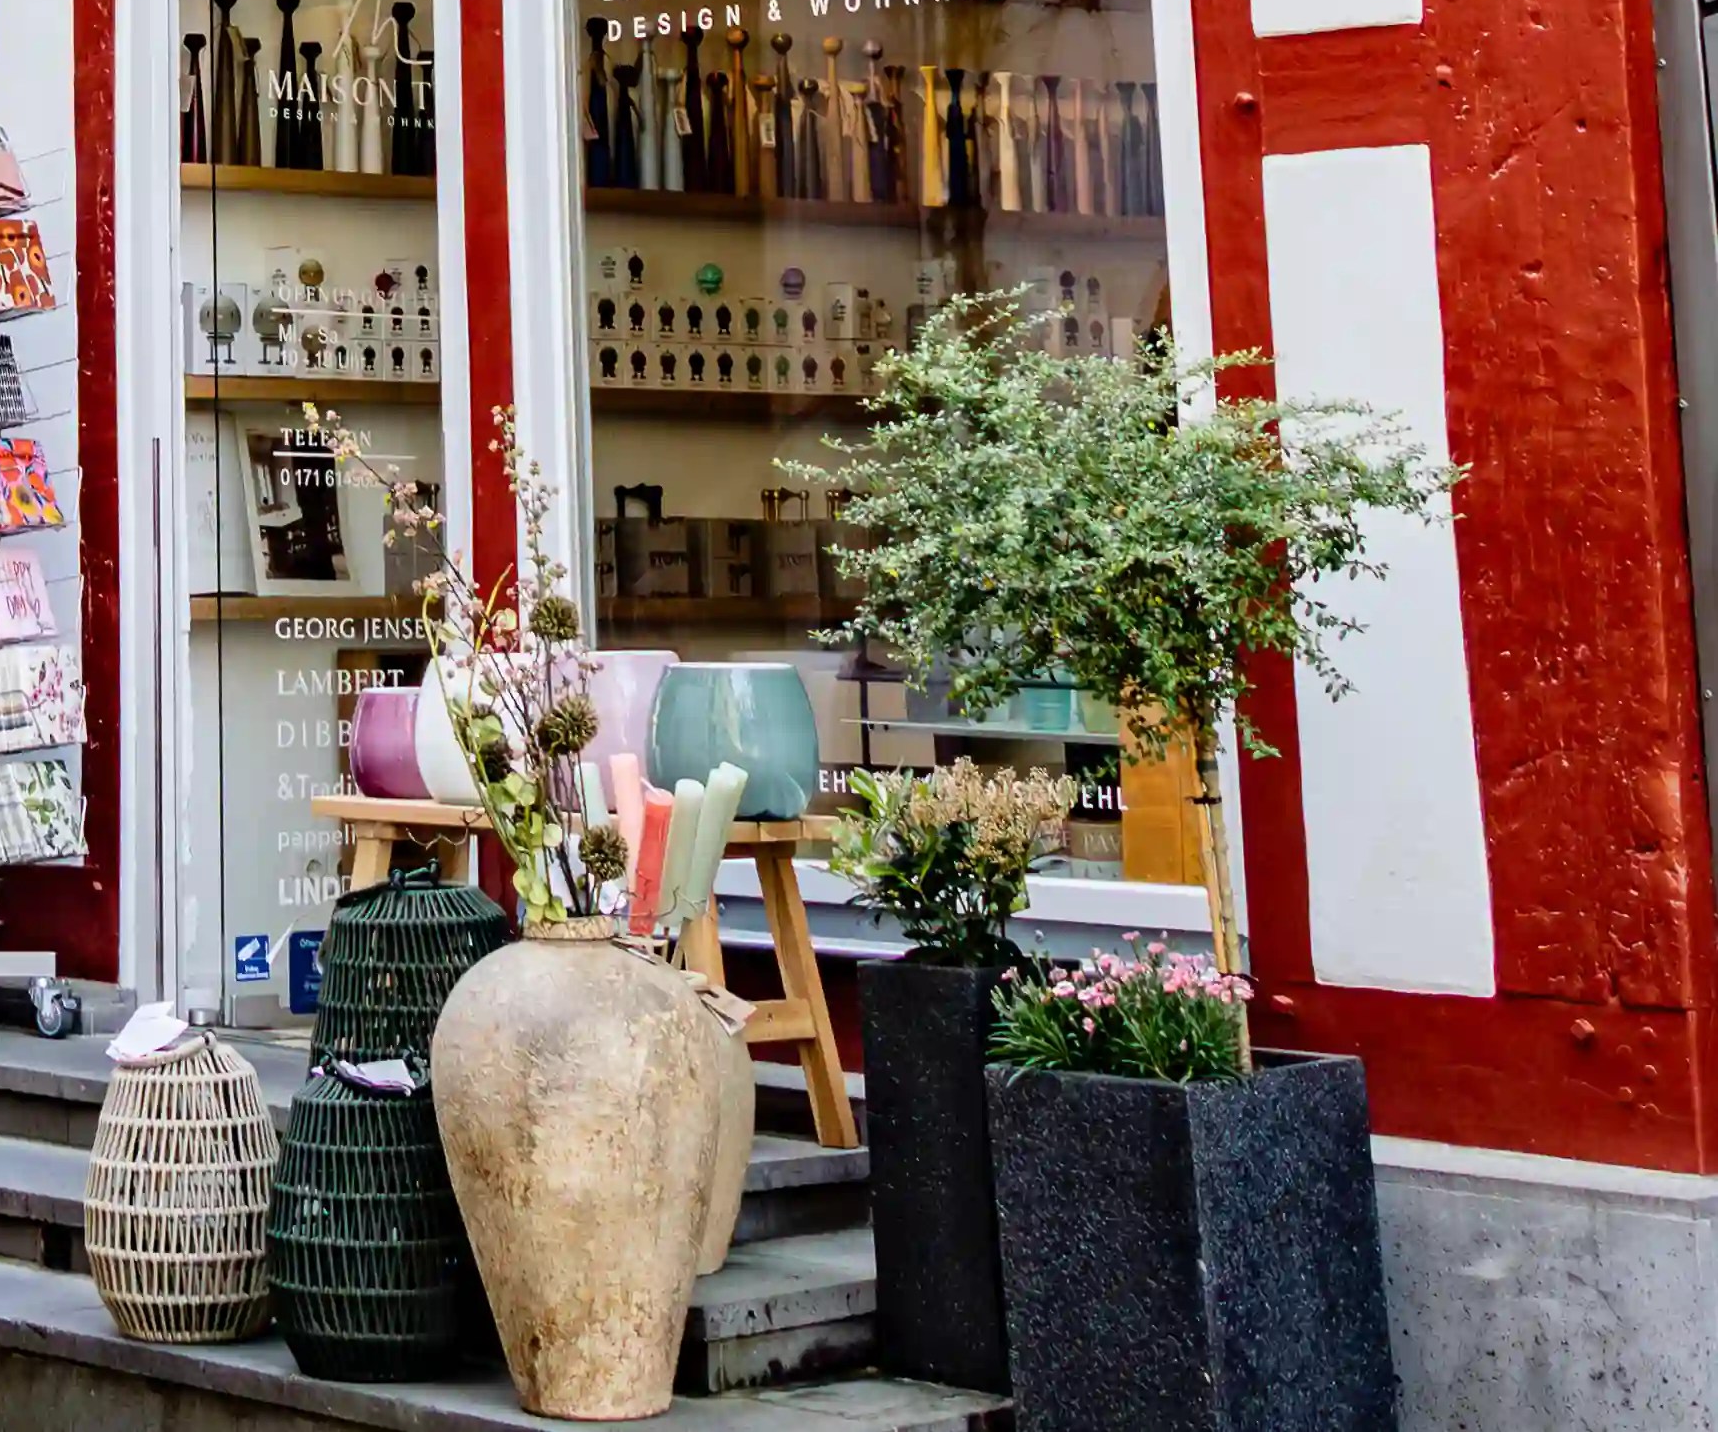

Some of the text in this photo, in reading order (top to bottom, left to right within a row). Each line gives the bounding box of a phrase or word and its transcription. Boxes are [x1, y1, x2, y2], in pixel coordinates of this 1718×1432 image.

[608, 4, 741, 42] DESIGN
[268, 69, 398, 109] MAISON
[269, 107, 339, 122] DESIGN
[318, 325, 338, 344] Sa
[280, 467, 291, 486] 0
[294, 468, 320, 488] 171
[275, 617, 356, 639] GEORG
[277, 669, 404, 696] LAMBERT
[277, 721, 352, 749] DIBB
[277, 773, 358, 801] &Tradi
[278, 824, 356, 854] pappeli
